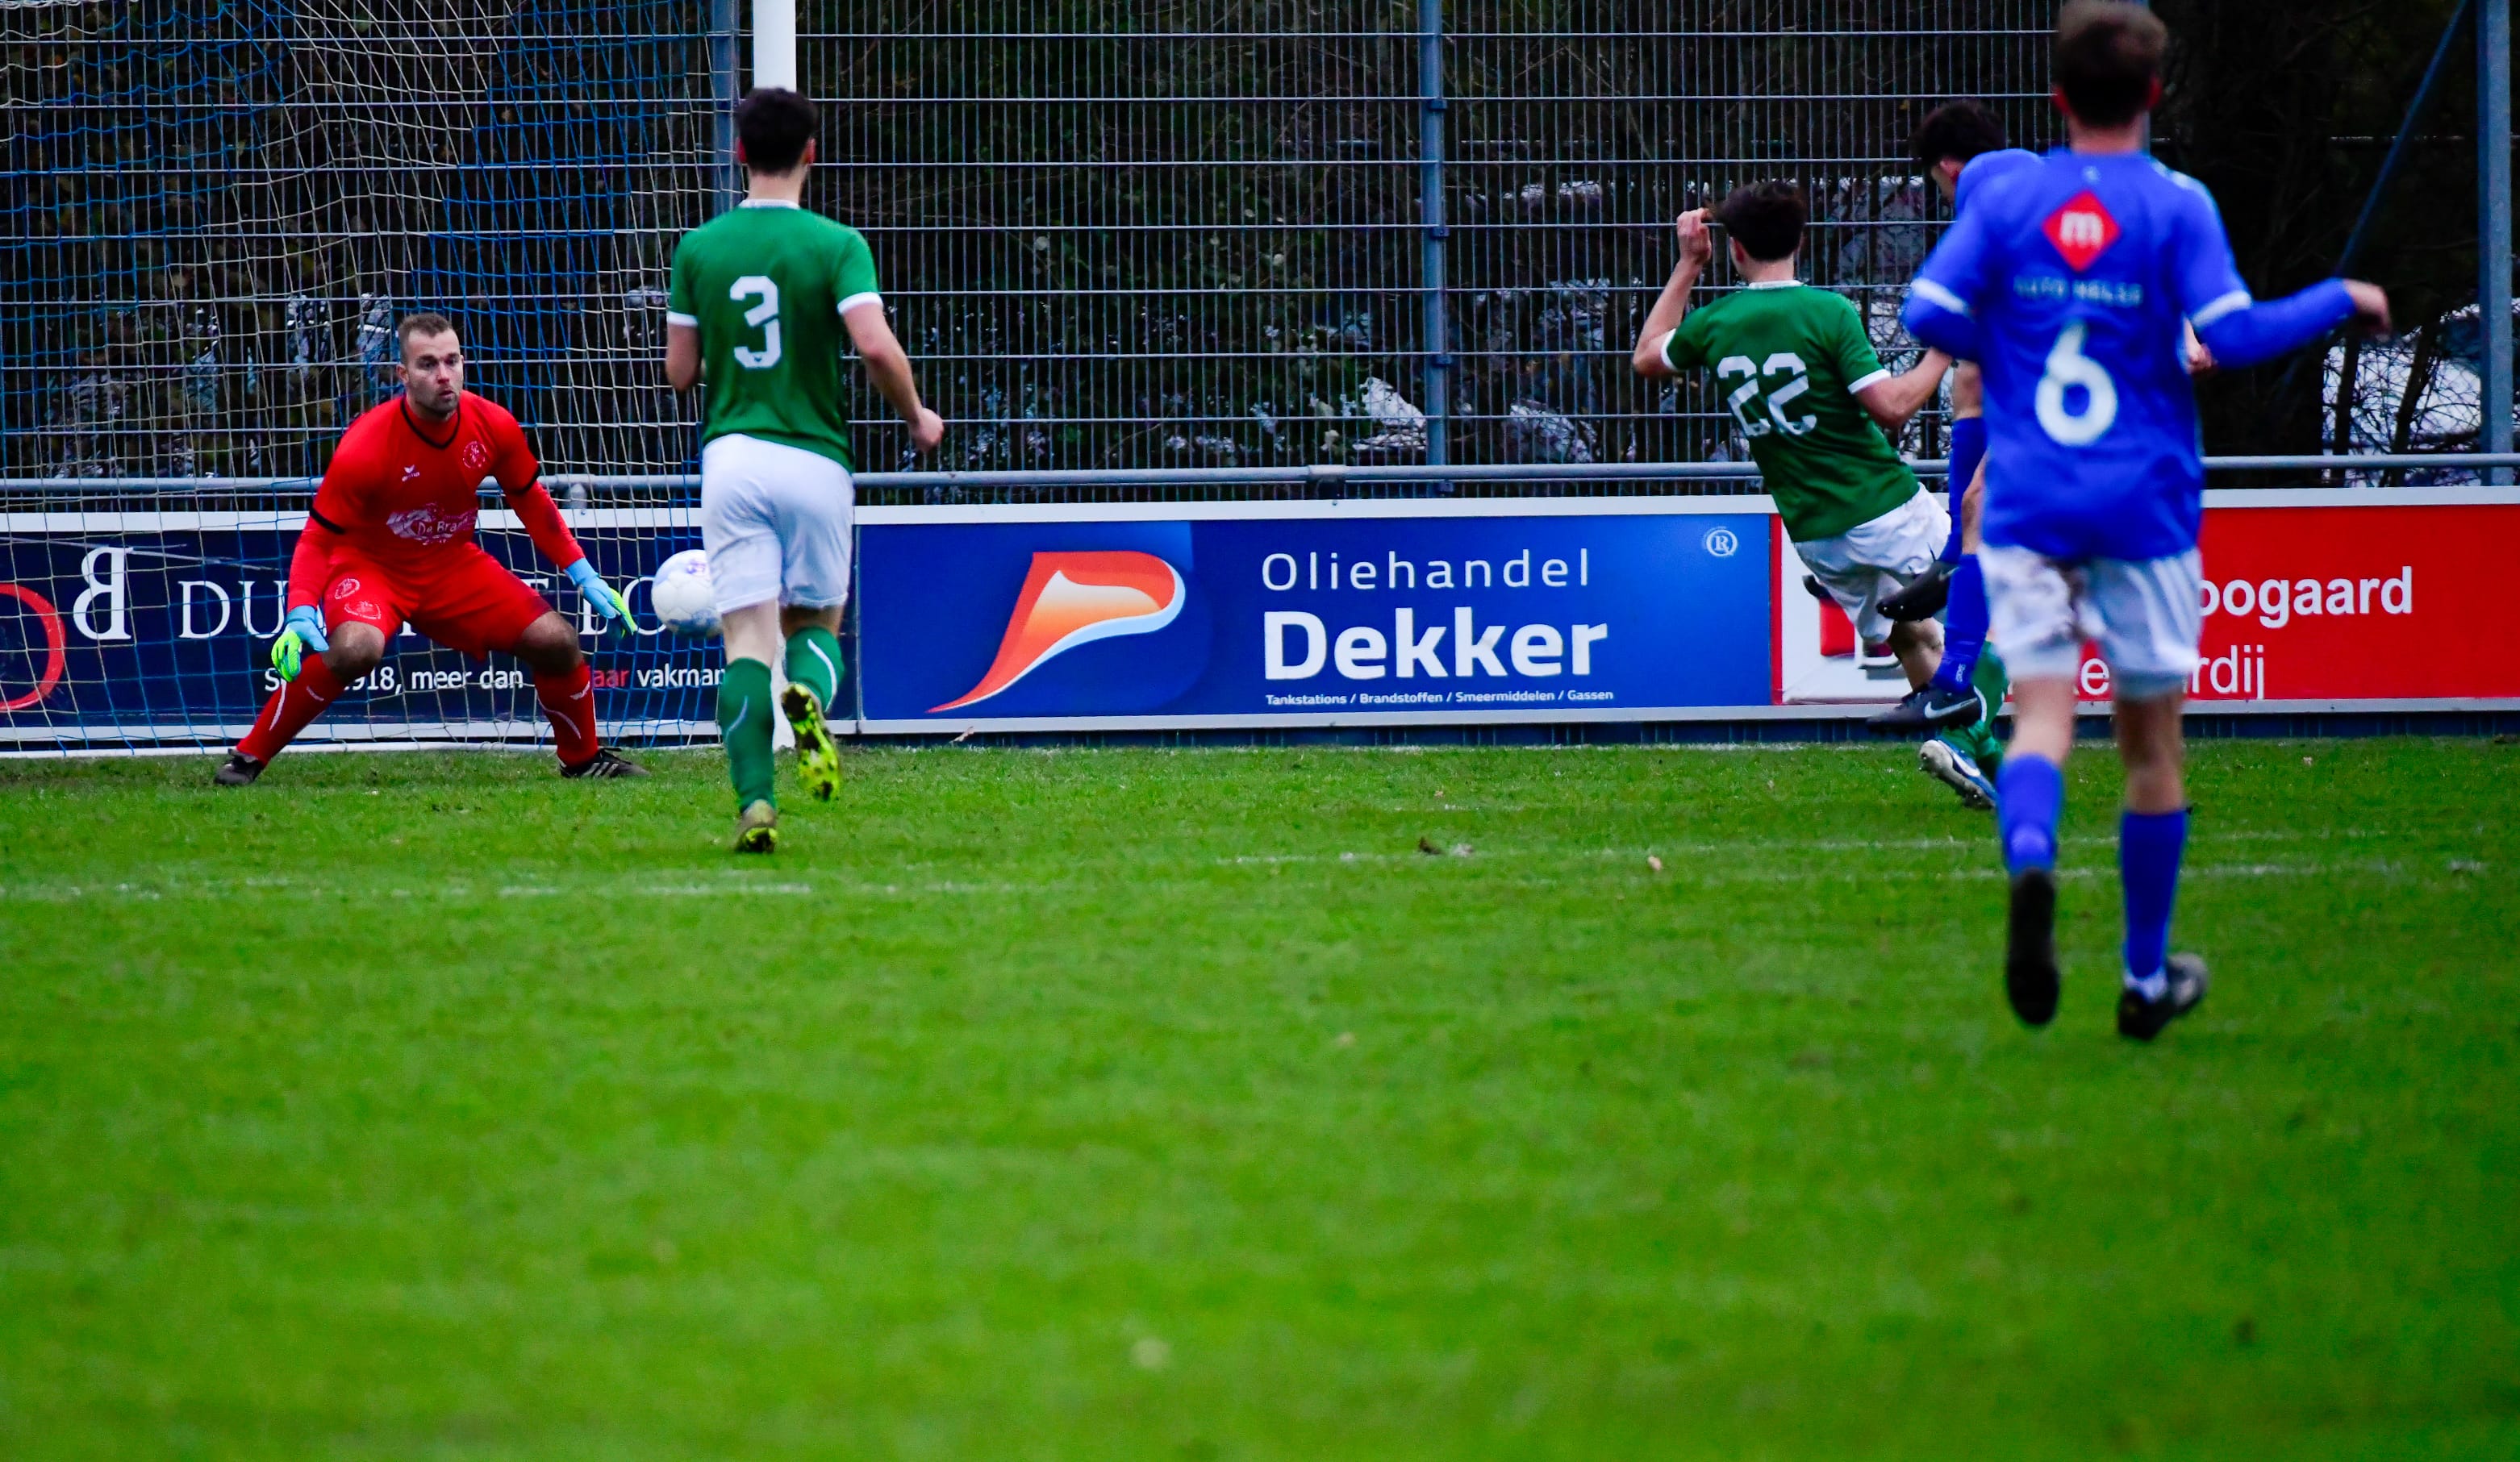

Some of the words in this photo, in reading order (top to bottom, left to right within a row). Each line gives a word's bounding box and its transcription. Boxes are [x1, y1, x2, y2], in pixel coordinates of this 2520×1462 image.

[729, 275, 782, 369] 3
[1717, 352, 1817, 436] 22
[2034, 319, 2118, 448] 6
[1262, 548, 1588, 591] Oliehandel
[2200, 565, 2413, 629] oogaard
[1263, 606, 1608, 681] Dekker
[411, 669, 472, 690] meer
[479, 665, 524, 690] dan
[593, 669, 630, 688] aar
[1265, 694, 1347, 706] Tankstations
[1360, 692, 1443, 704] Brandstoffen
[1455, 690, 1555, 702] Smeermiddelen
[1567, 689, 1614, 701] Gassen
